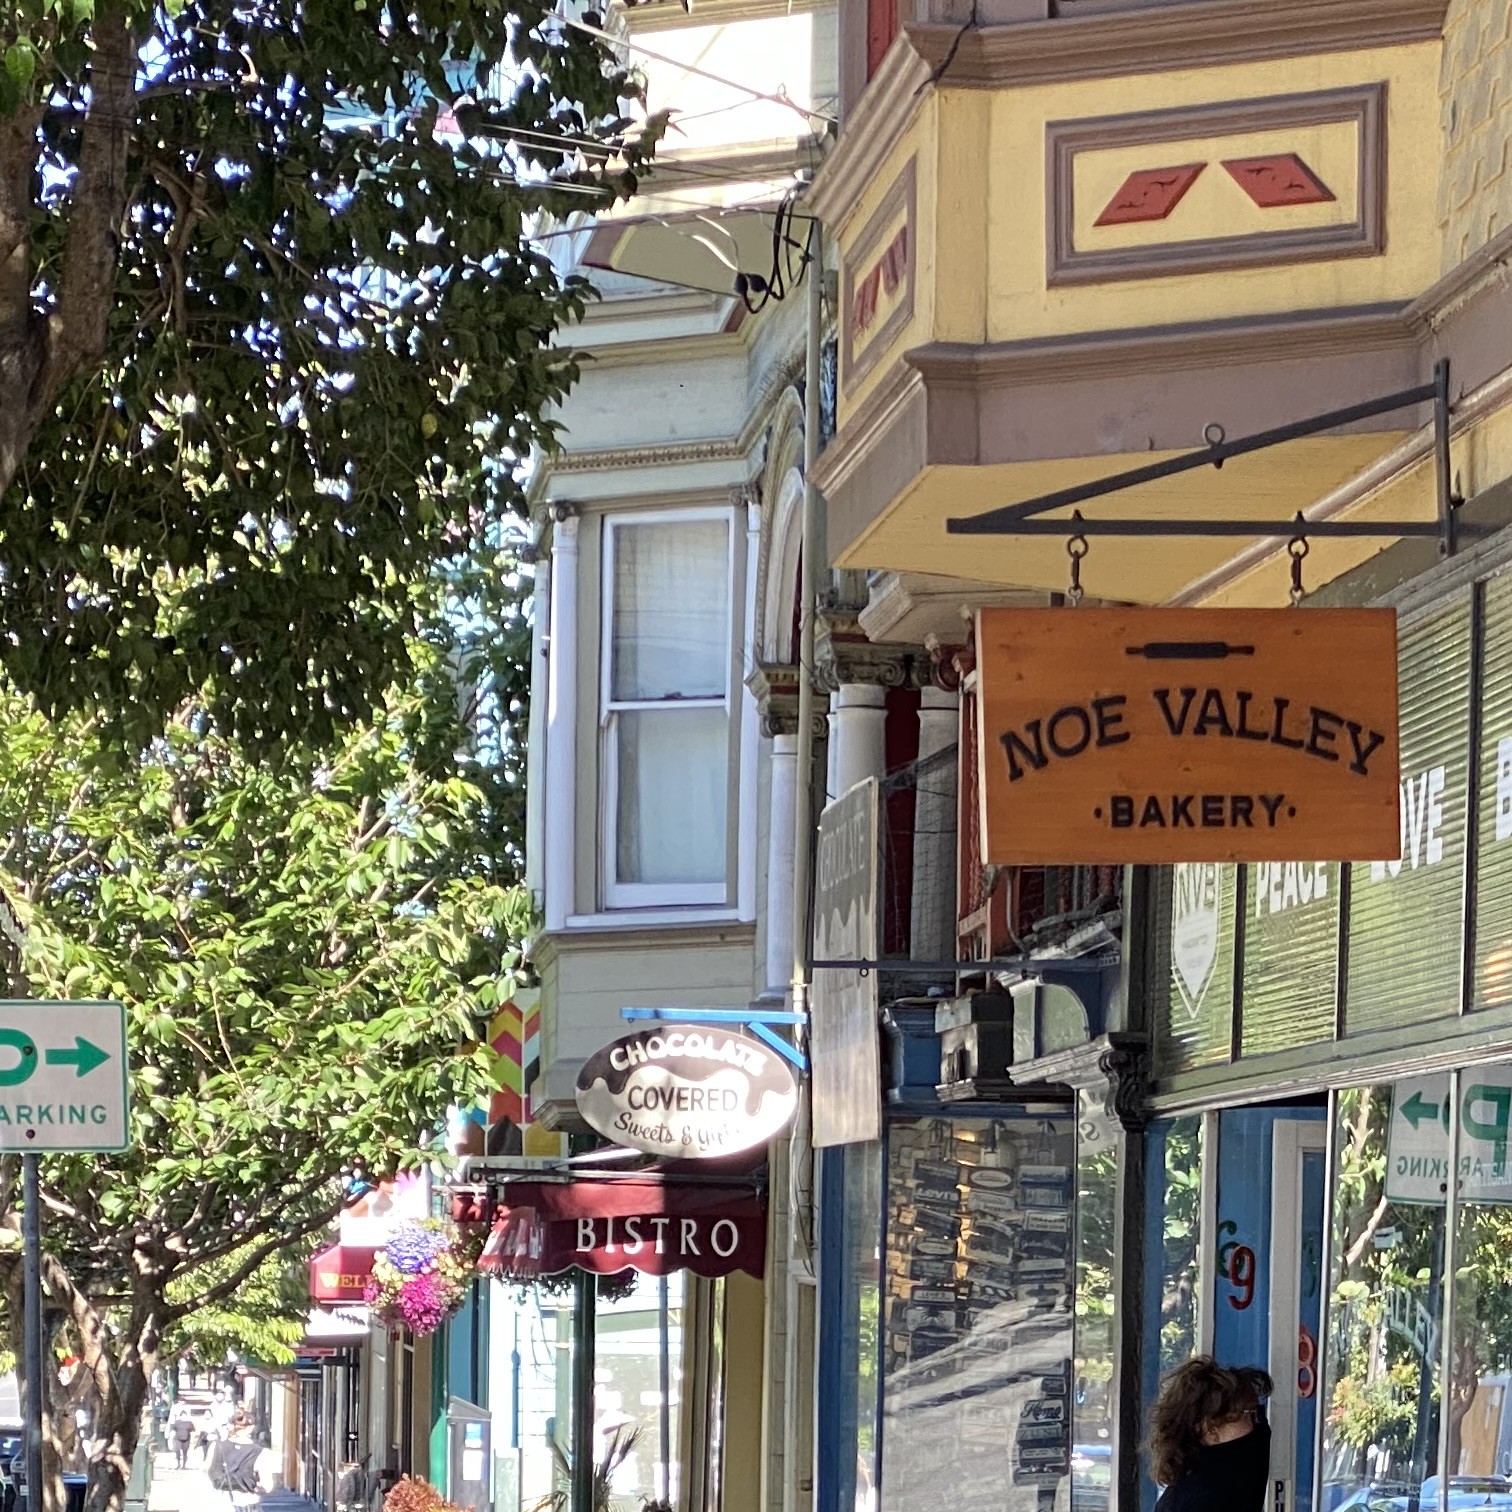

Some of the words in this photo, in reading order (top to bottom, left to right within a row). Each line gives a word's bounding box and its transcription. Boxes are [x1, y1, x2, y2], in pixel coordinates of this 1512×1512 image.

[1000, 694, 1131, 783] NOE
[1152, 687, 1385, 776] VALLEY
[1110, 794, 1286, 829] BAKERY
[1371, 765, 1445, 883] OVE
[609, 1033, 769, 1077] CHOCOLATE
[628, 1085, 739, 1112] COVERED
[614, 1111, 676, 1143] Sweets
[576, 1216, 740, 1258] BISTRO
